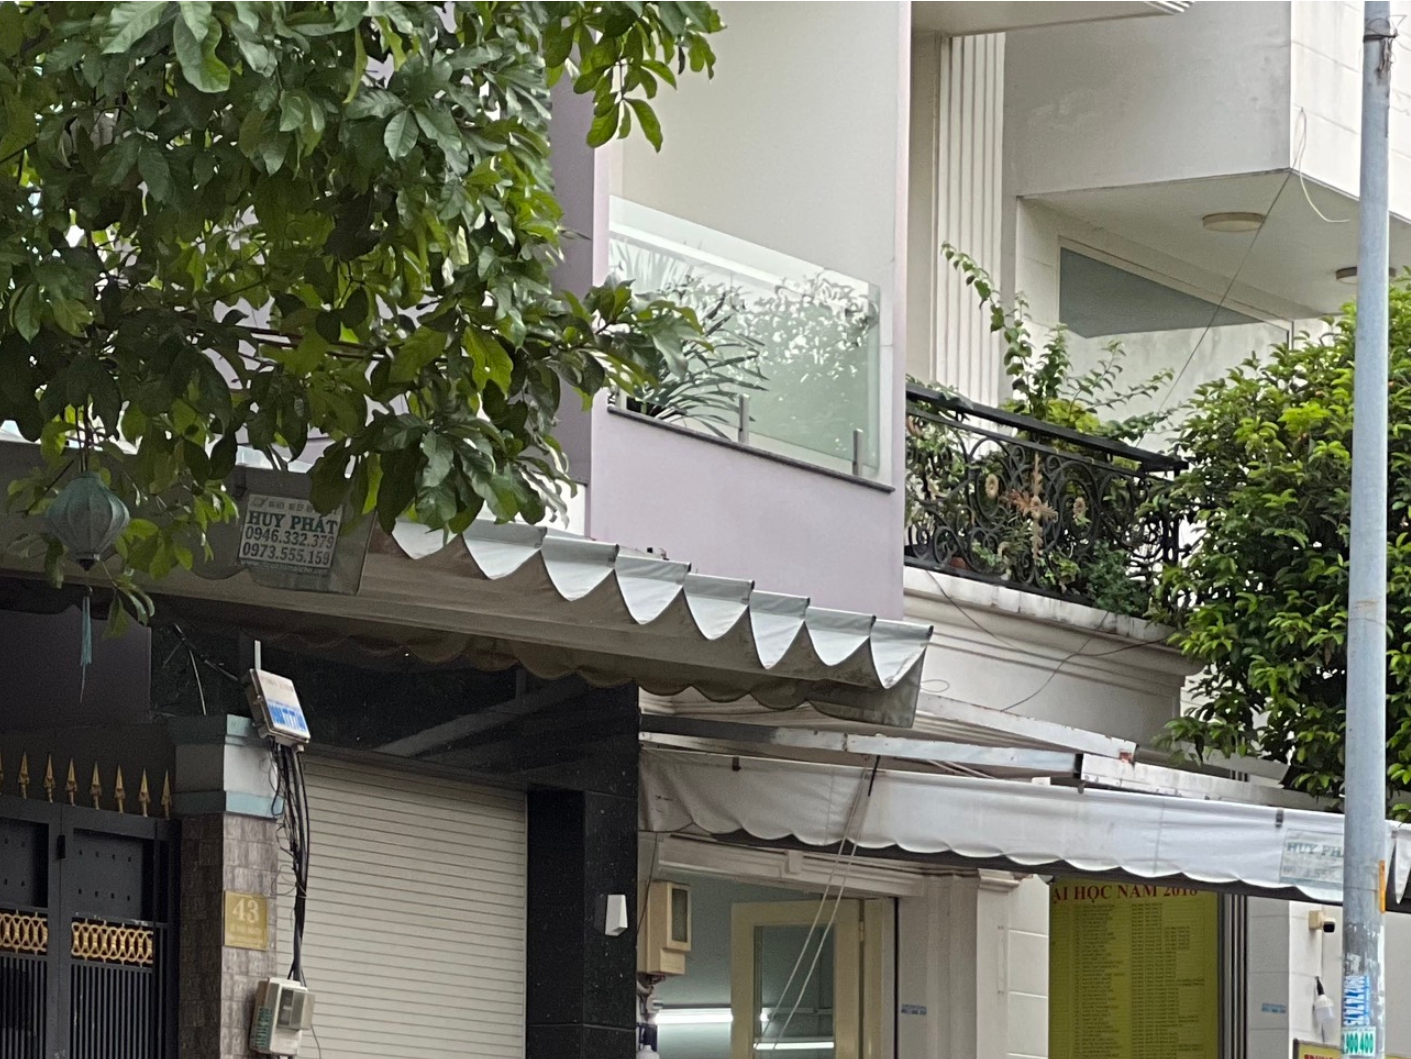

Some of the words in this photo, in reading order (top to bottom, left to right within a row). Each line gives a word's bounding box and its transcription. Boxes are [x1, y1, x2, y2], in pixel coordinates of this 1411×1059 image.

[247, 510, 286, 528] HUY
[1074, 884, 1112, 903] HỌC
[233, 900, 259, 923] 43
